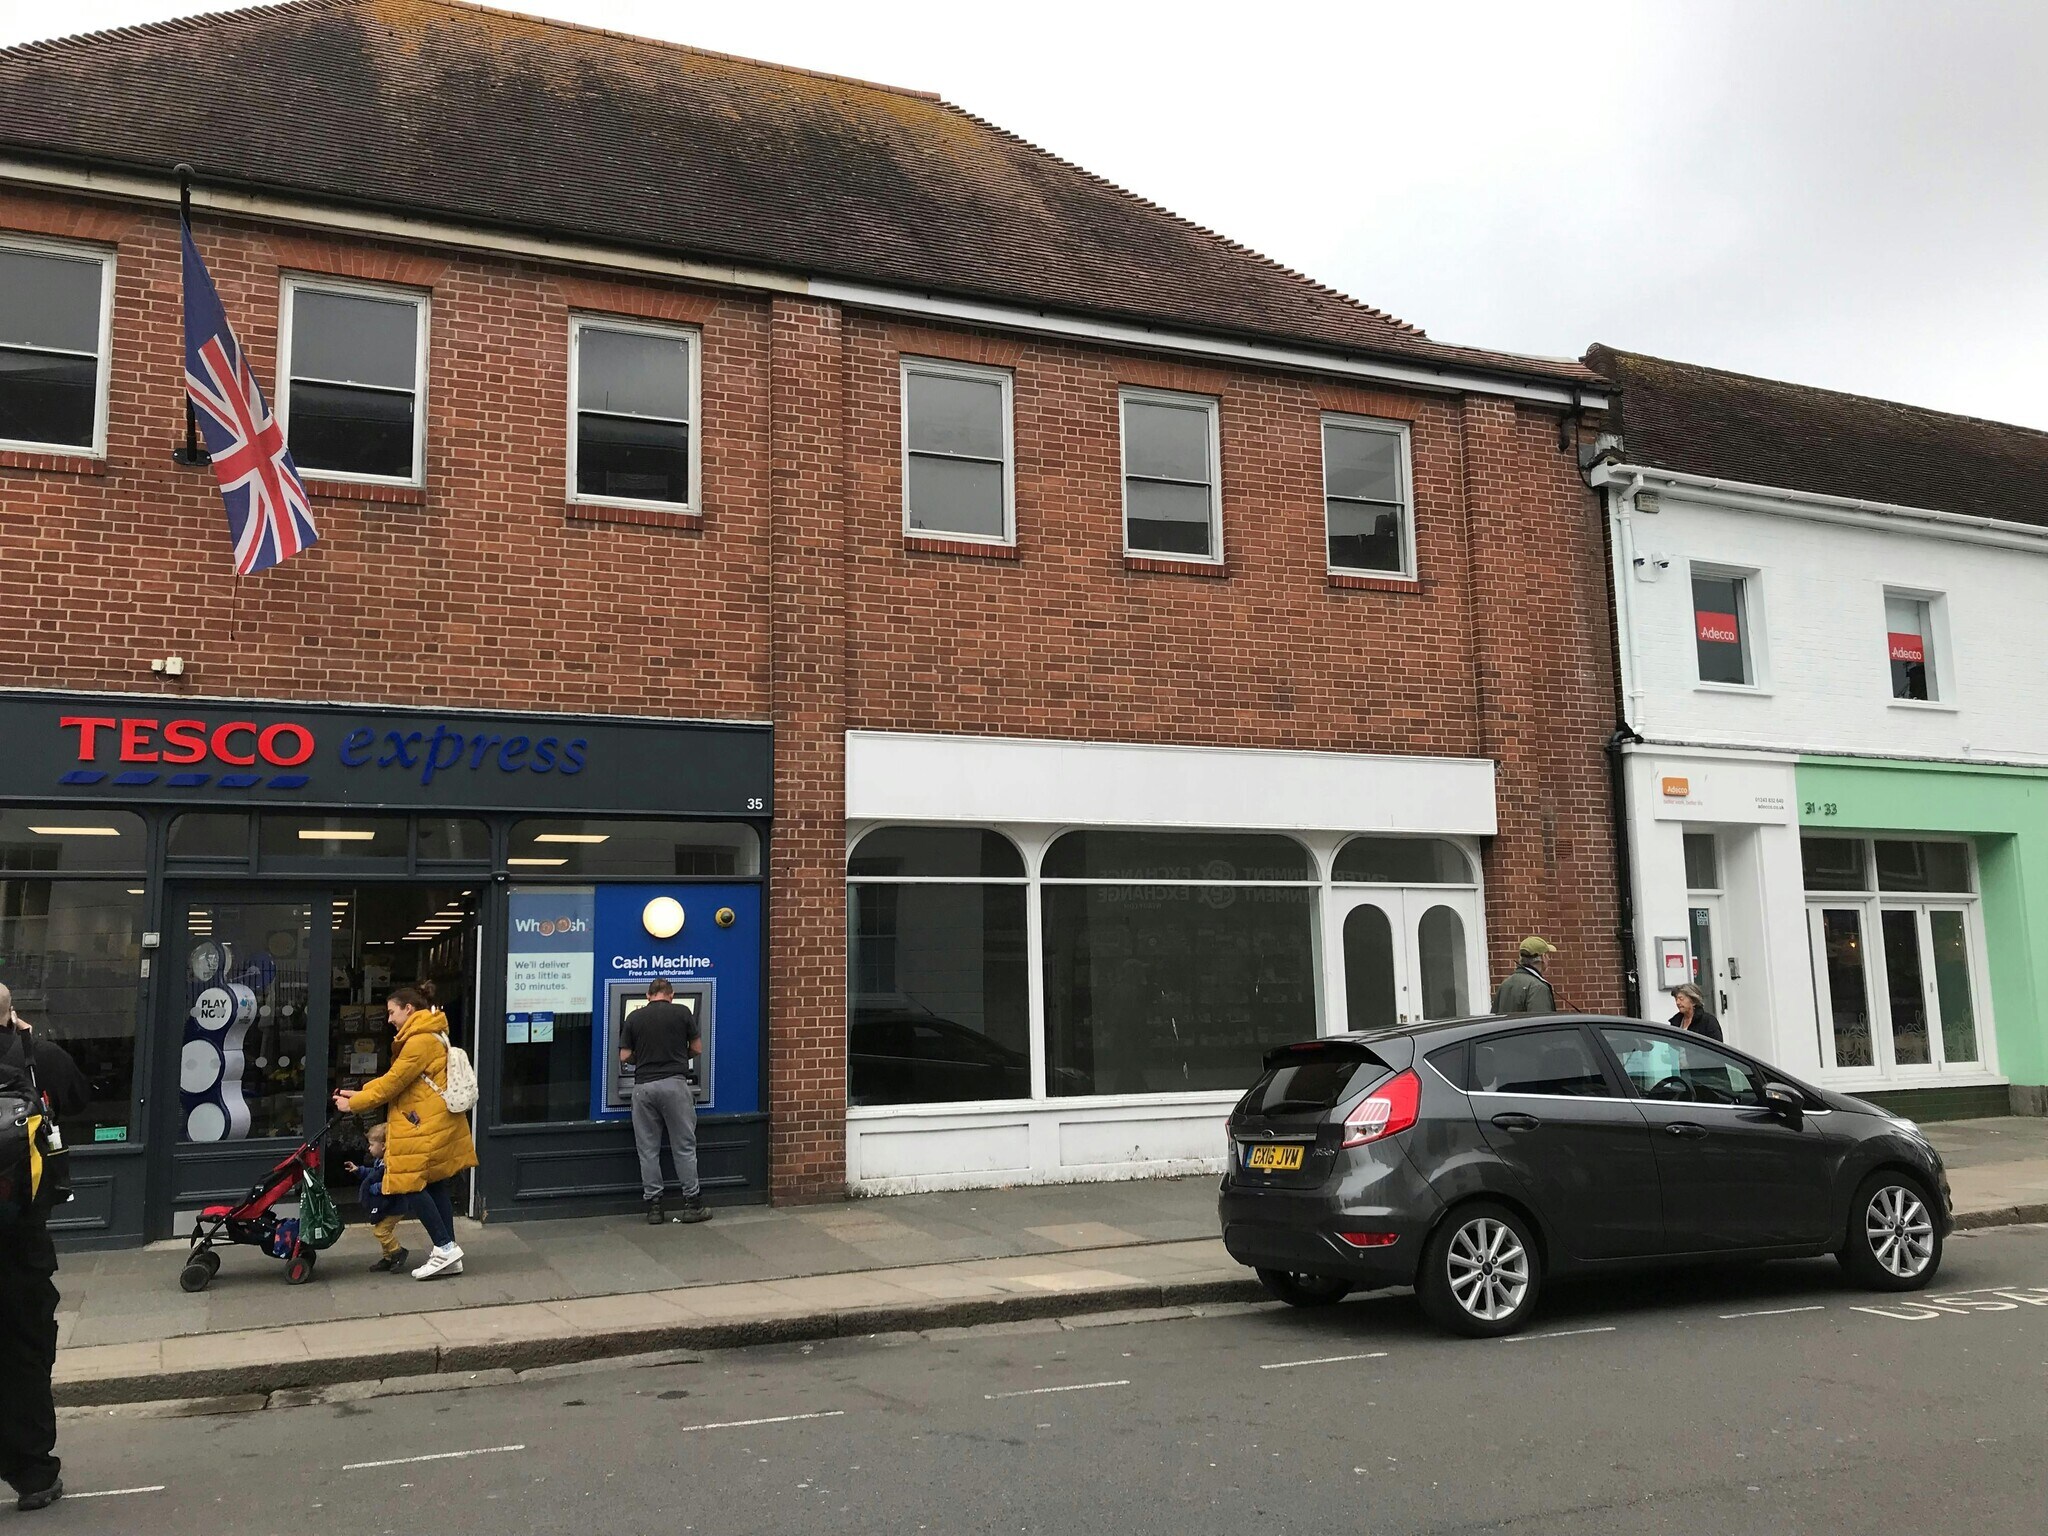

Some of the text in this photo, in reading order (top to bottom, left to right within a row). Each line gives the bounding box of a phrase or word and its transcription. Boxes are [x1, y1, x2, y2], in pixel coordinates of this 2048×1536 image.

[1701, 627, 1735, 641] Adecco
[1891, 647, 1922, 660] Adecco
[60, 716, 588, 785] TESCO express
[1667, 786, 1688, 794] Adecco
[747, 798, 763, 810] 35
[1805, 802, 1815, 815] 31
[1824, 803, 1838, 815] 33
[514, 961, 570, 969] We'll deliver
[612, 955, 648, 969] Cash
[514, 972, 523, 980] in
[538, 971, 559, 979] little
[514, 982, 568, 991] 30 minutes.
[201, 999, 227, 1009] PLAY
[201, 1009, 226, 1018] NO
[1253, 1146, 1300, 1166] GX16 JVM
